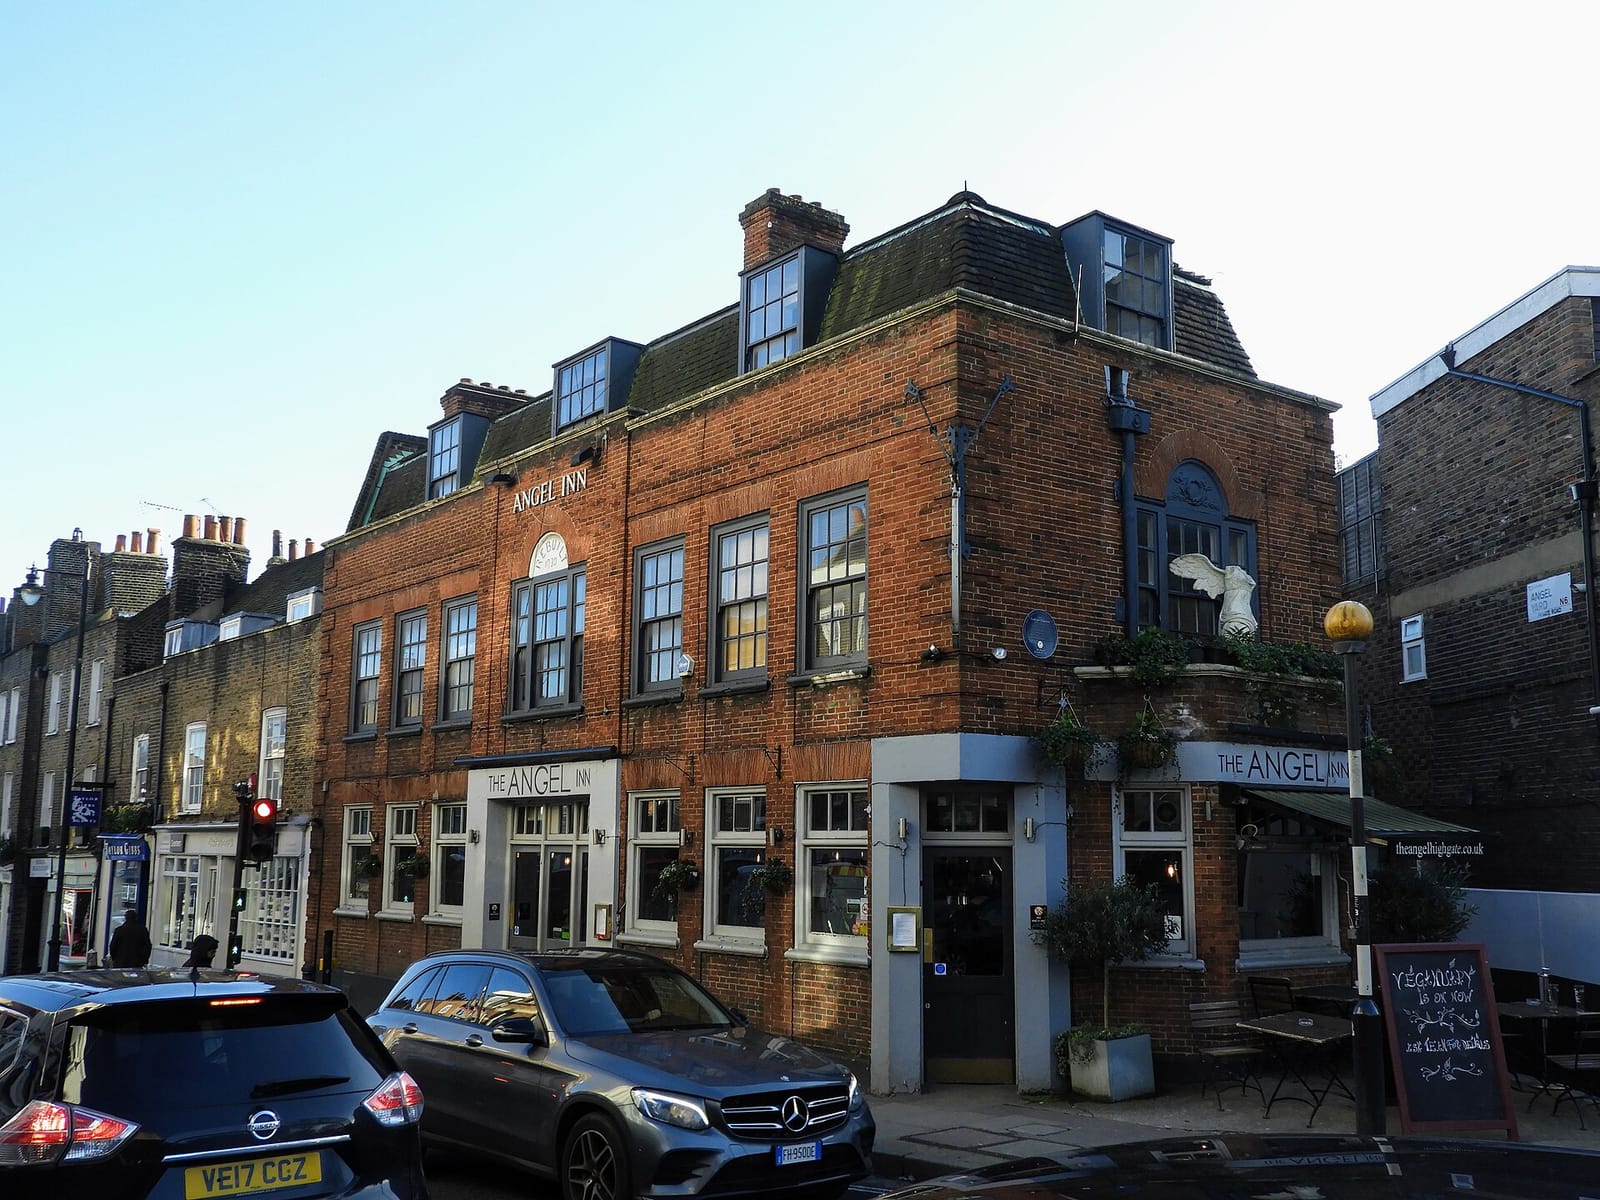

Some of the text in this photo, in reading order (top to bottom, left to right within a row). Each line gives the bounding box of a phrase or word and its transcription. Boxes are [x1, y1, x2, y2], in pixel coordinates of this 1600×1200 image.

[513, 469, 588, 514] ANGEL INN
[535, 540, 568, 569] REBUILT
[1531, 588, 1552, 601] ANGEL
[1218, 750, 1350, 782] THE ANGEL INN
[489, 765, 591, 796] THE ANGEL INN
[123, 842, 141, 856] GIBBS
[1396, 841, 1484, 858] theangelhighgate.co.uk
[1418, 987, 1430, 1005] IS
[1450, 989, 1474, 1003] NOW
[250, 1121, 280, 1131] NISSAN
[202, 1157, 307, 1192] VE17 CCZ
